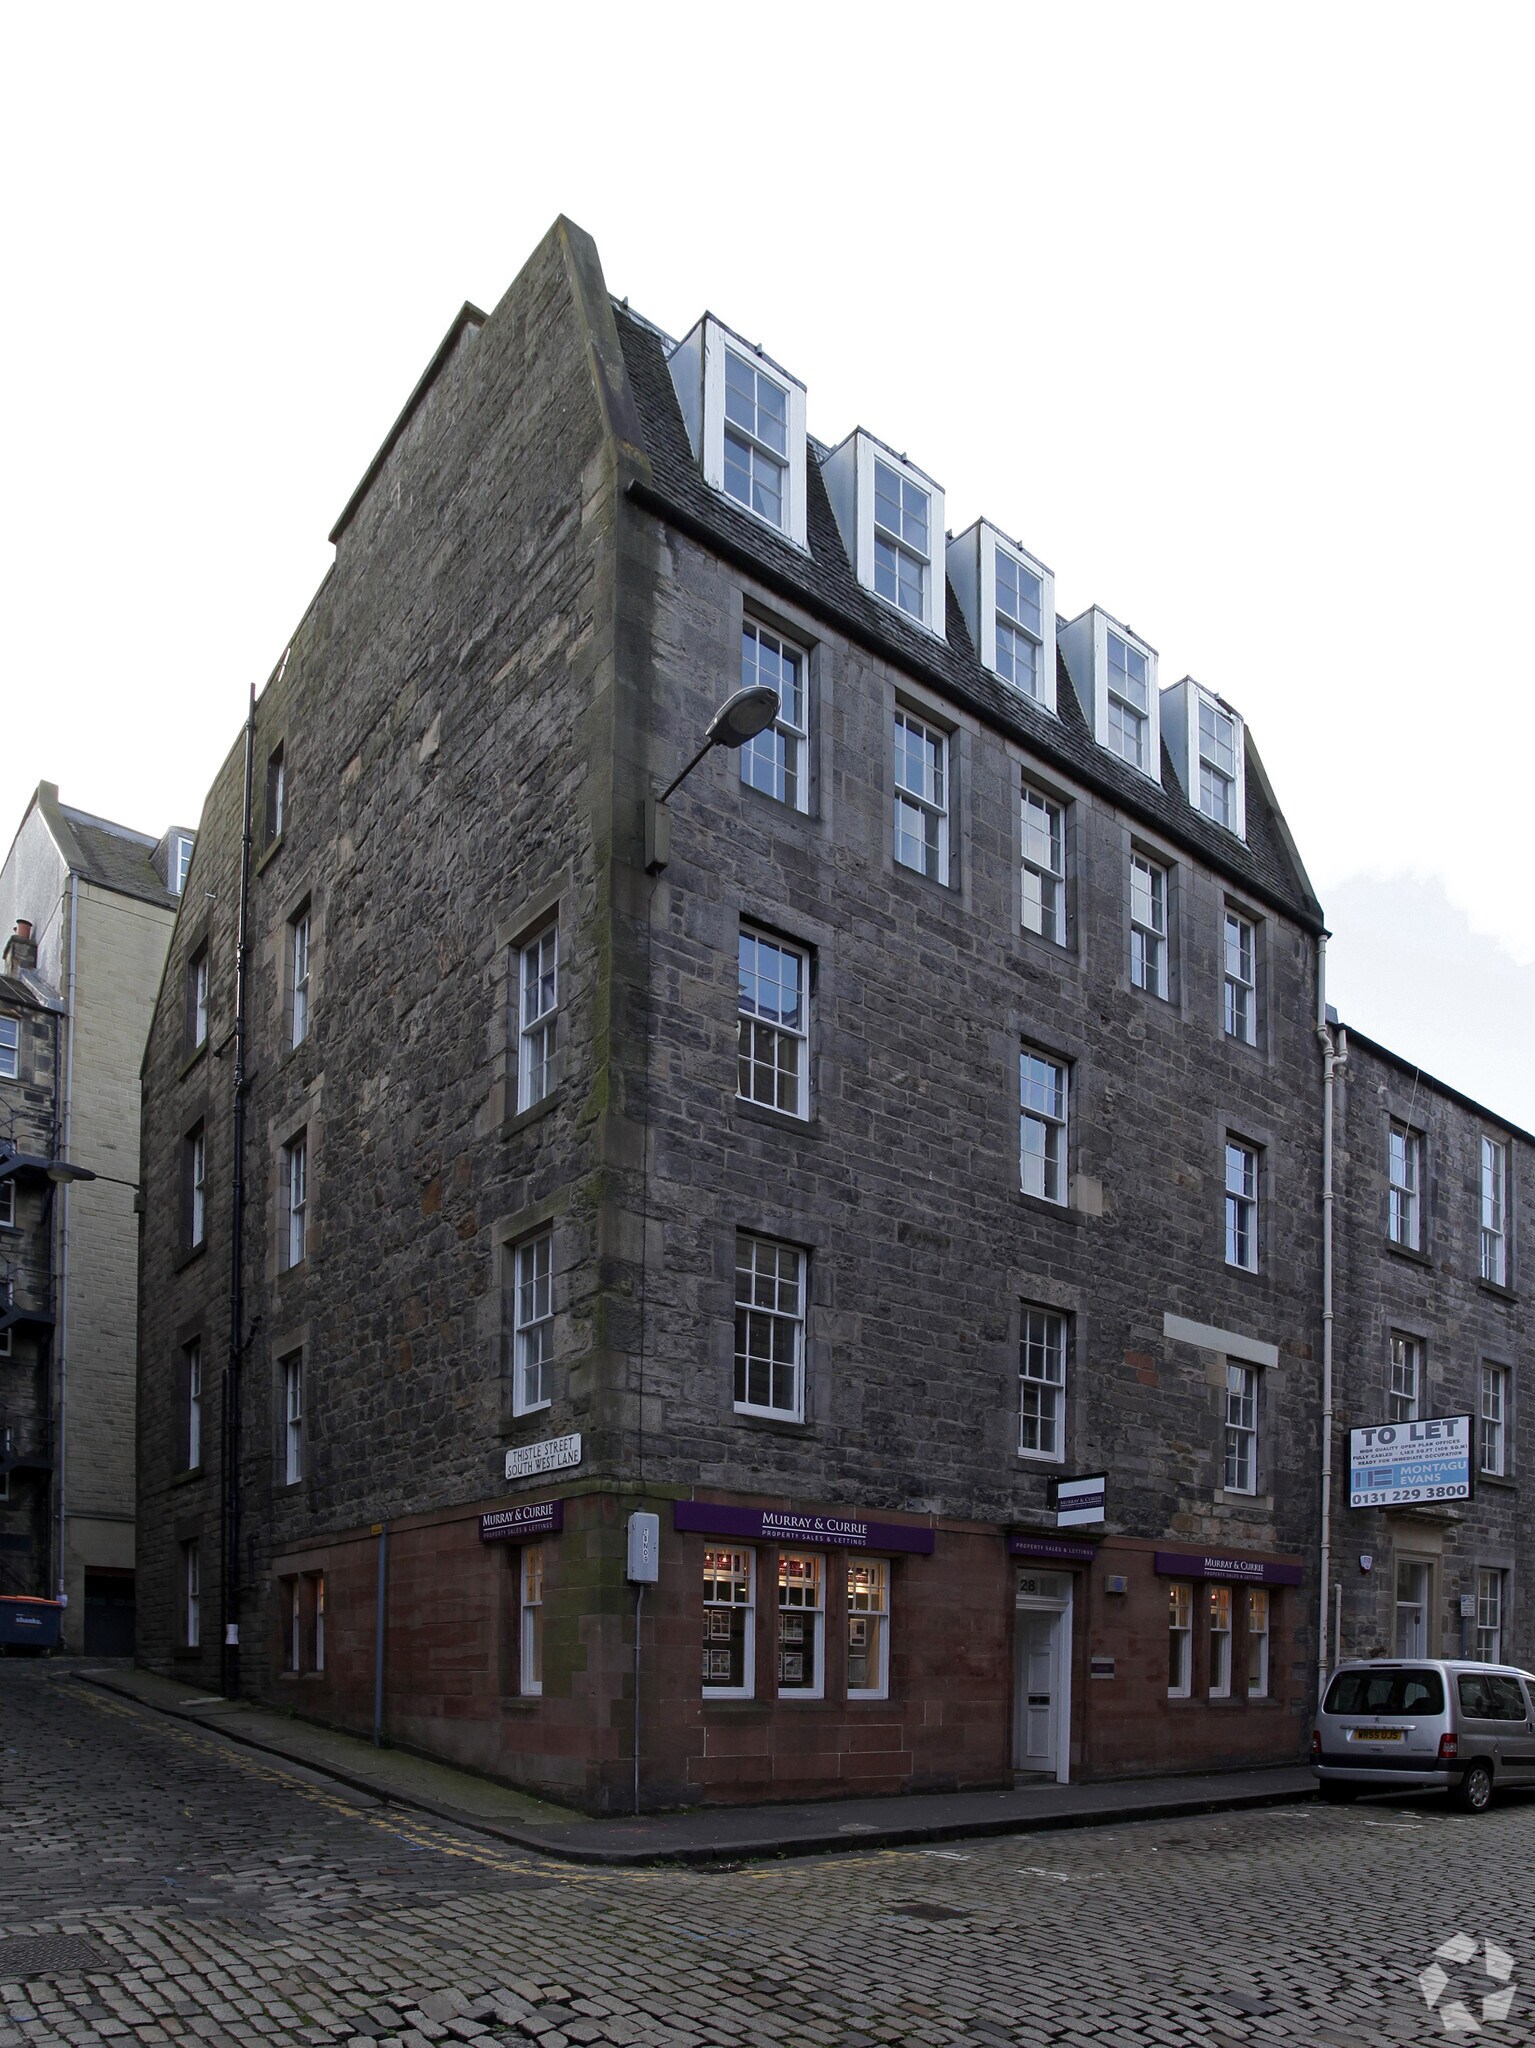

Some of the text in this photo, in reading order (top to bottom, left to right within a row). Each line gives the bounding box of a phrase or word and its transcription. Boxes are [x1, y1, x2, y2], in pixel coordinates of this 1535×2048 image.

[1361, 1419, 1458, 1446] TO LET
[513, 1437, 573, 1463] THISTLE STREET
[1424, 1451, 1463, 1459] OCCUPATION
[508, 1449, 578, 1477] SOUTH WEST LANE
[1400, 1461, 1467, 1476] MONTAGU
[1400, 1473, 1441, 1485] EVANS
[1352, 1485, 1467, 1505] 0131 229 3800
[482, 1503, 553, 1527] MURRAY & CURRIE
[762, 1511, 868, 1534] MURRAY & CURRIE
[483, 1529, 506, 1539] PROPERTY
[507, 1526, 522, 1536] SALES
[528, 1521, 553, 1532] LETTINGS
[761, 1529, 799, 1539] PROPERTY
[802, 1533, 823, 1542] SALES
[834, 1537, 867, 1546] LETTINGS
[1015, 1542, 1043, 1550] PROPERTY
[1045, 1544, 1062, 1553] SALES
[1068, 1547, 1094, 1556] LETTINGS
[1204, 1557, 1264, 1572] MURRAY & CURRIE
[1020, 1579, 1036, 1592] 28
